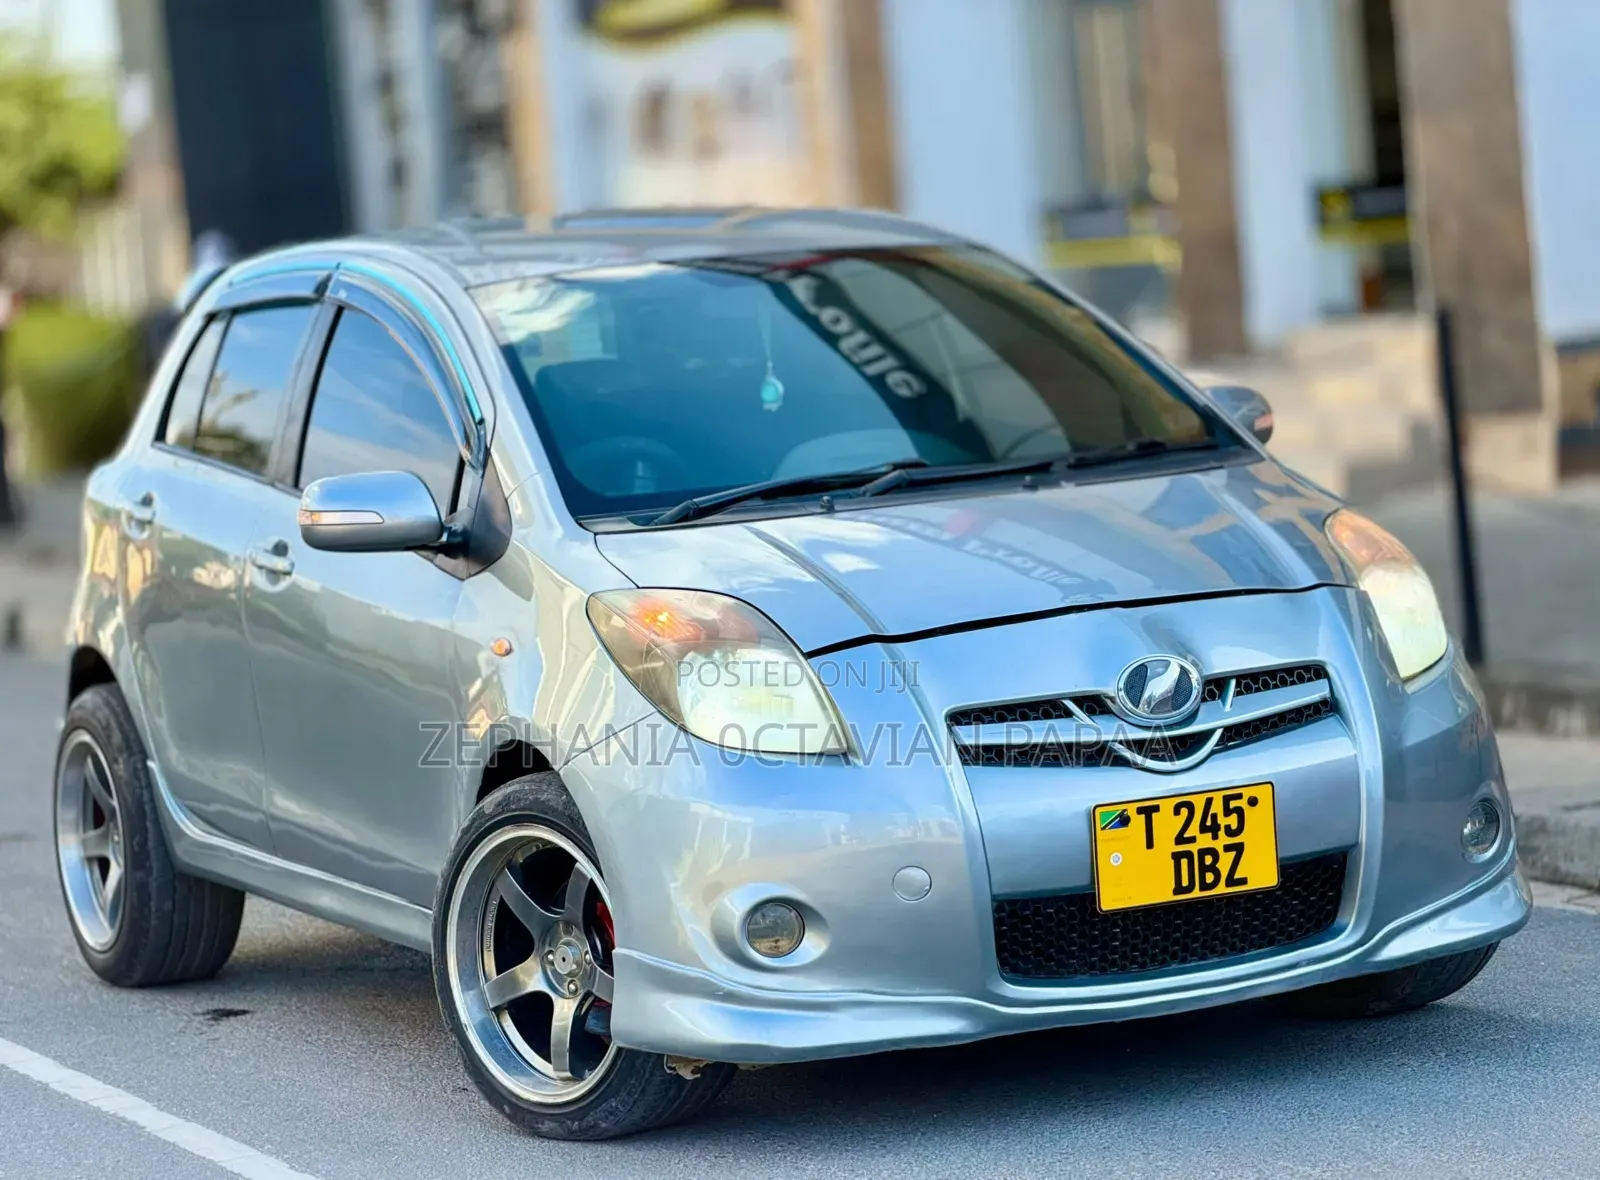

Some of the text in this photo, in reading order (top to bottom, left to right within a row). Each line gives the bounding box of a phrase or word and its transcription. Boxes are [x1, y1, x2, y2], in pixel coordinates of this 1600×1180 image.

[1136, 792, 1246, 850] T 245
[1171, 842, 1248, 896] DBZ
